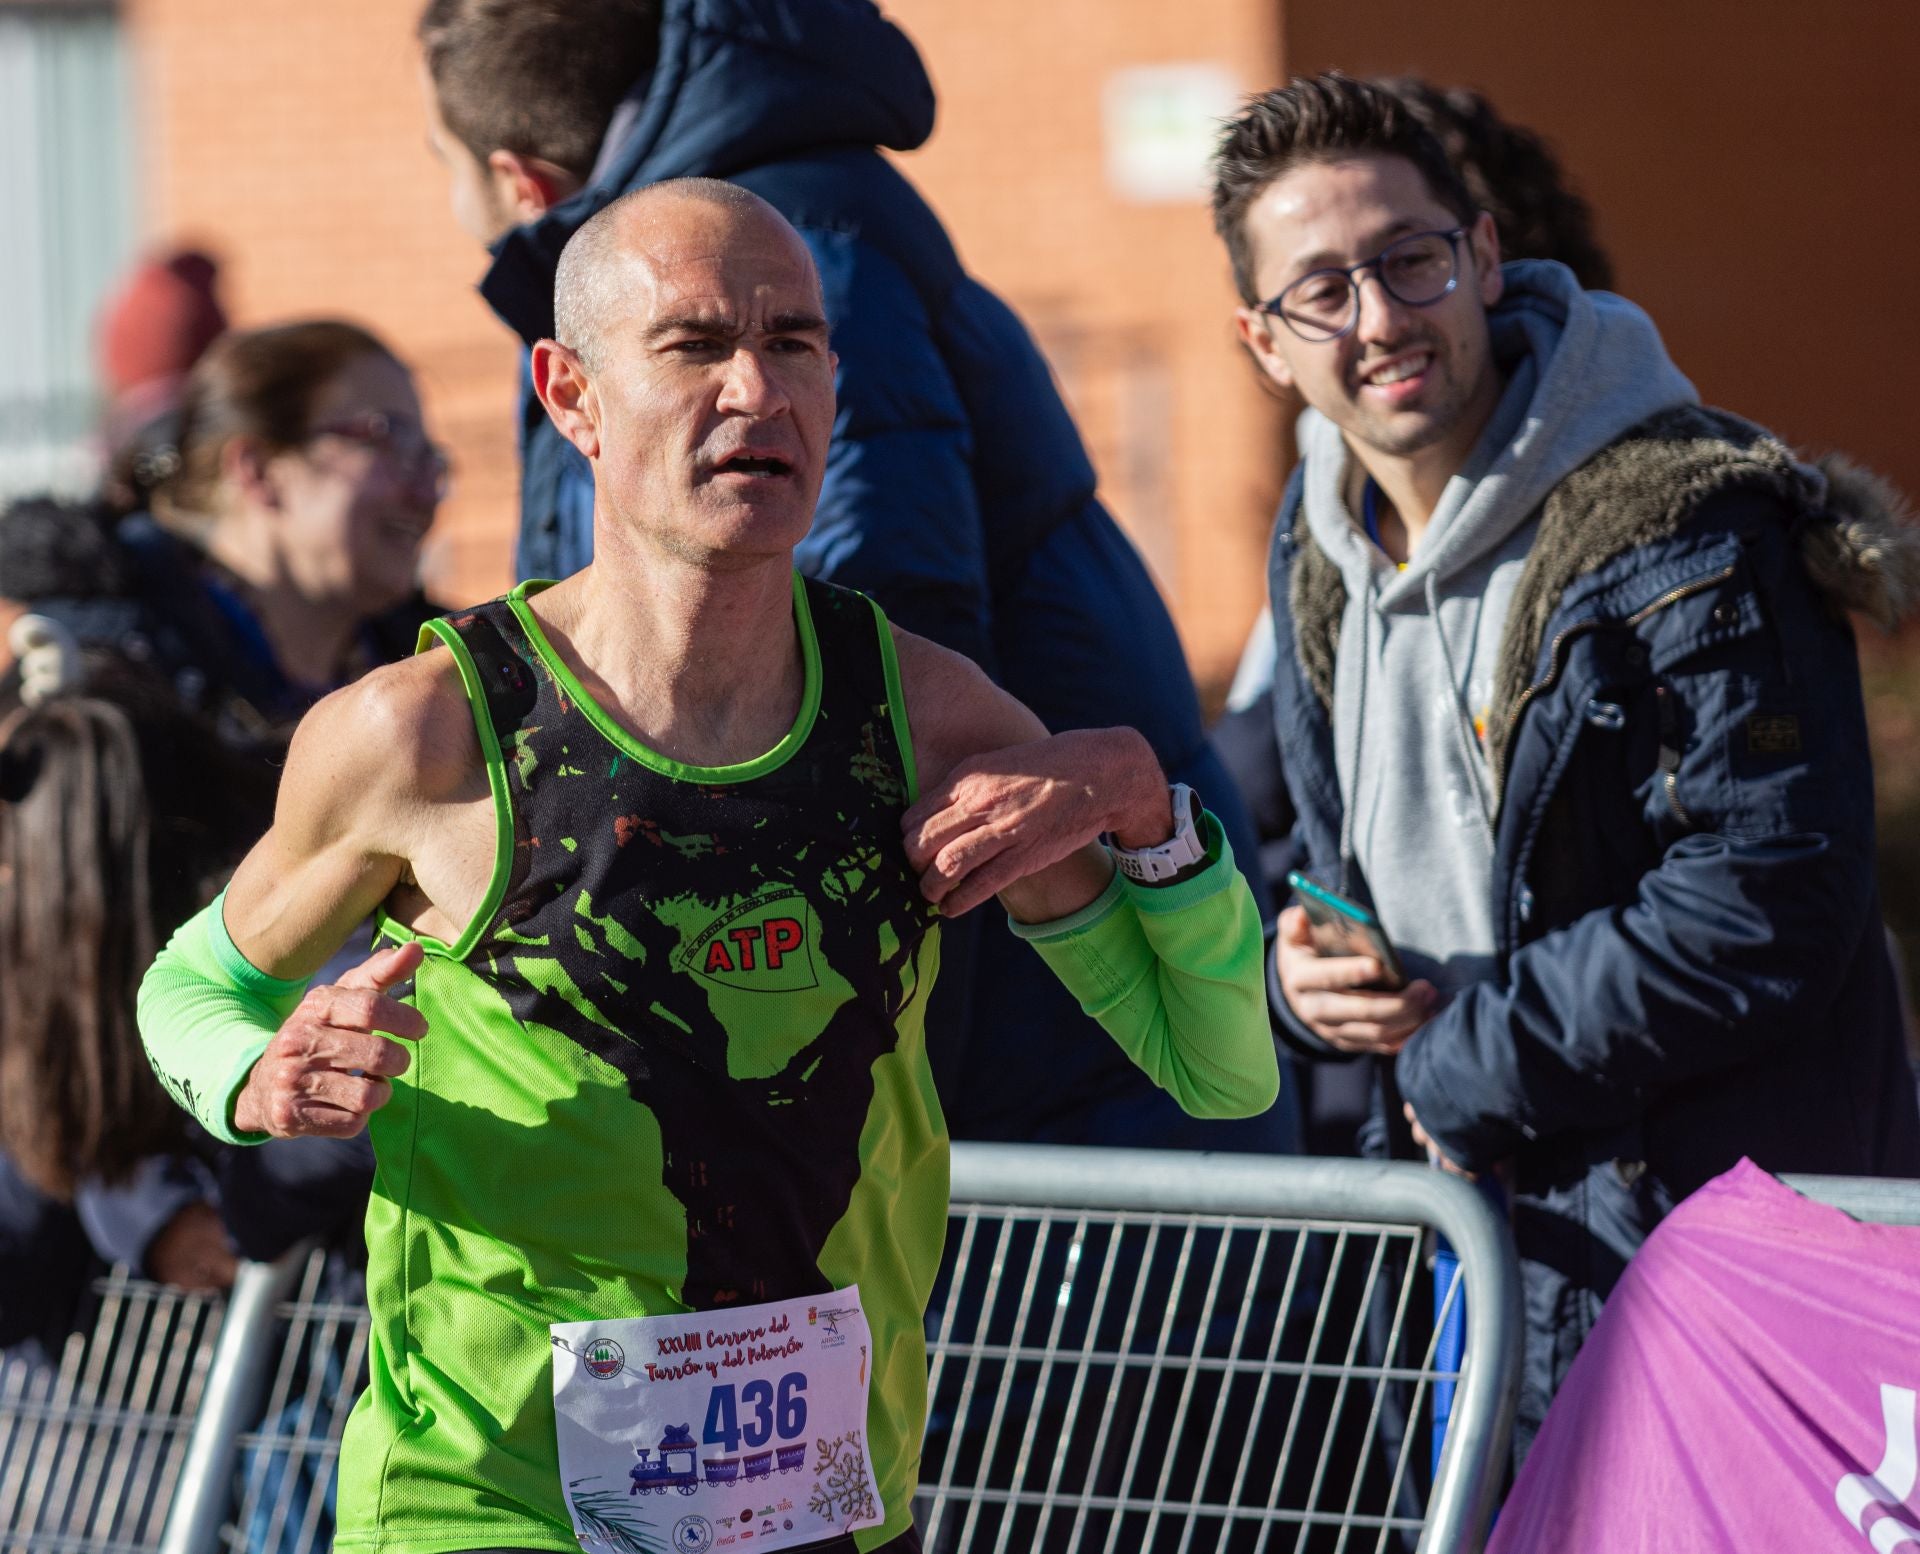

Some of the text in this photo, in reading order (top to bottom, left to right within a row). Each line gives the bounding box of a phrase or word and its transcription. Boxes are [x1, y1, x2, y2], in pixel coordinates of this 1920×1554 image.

[704, 917, 803, 974] ATP
[706, 1327, 766, 1349] Carrera
[769, 1314, 790, 1333] del
[706, 1361, 719, 1379] y
[722, 1348, 746, 1368] del
[702, 1372, 808, 1452] 436
